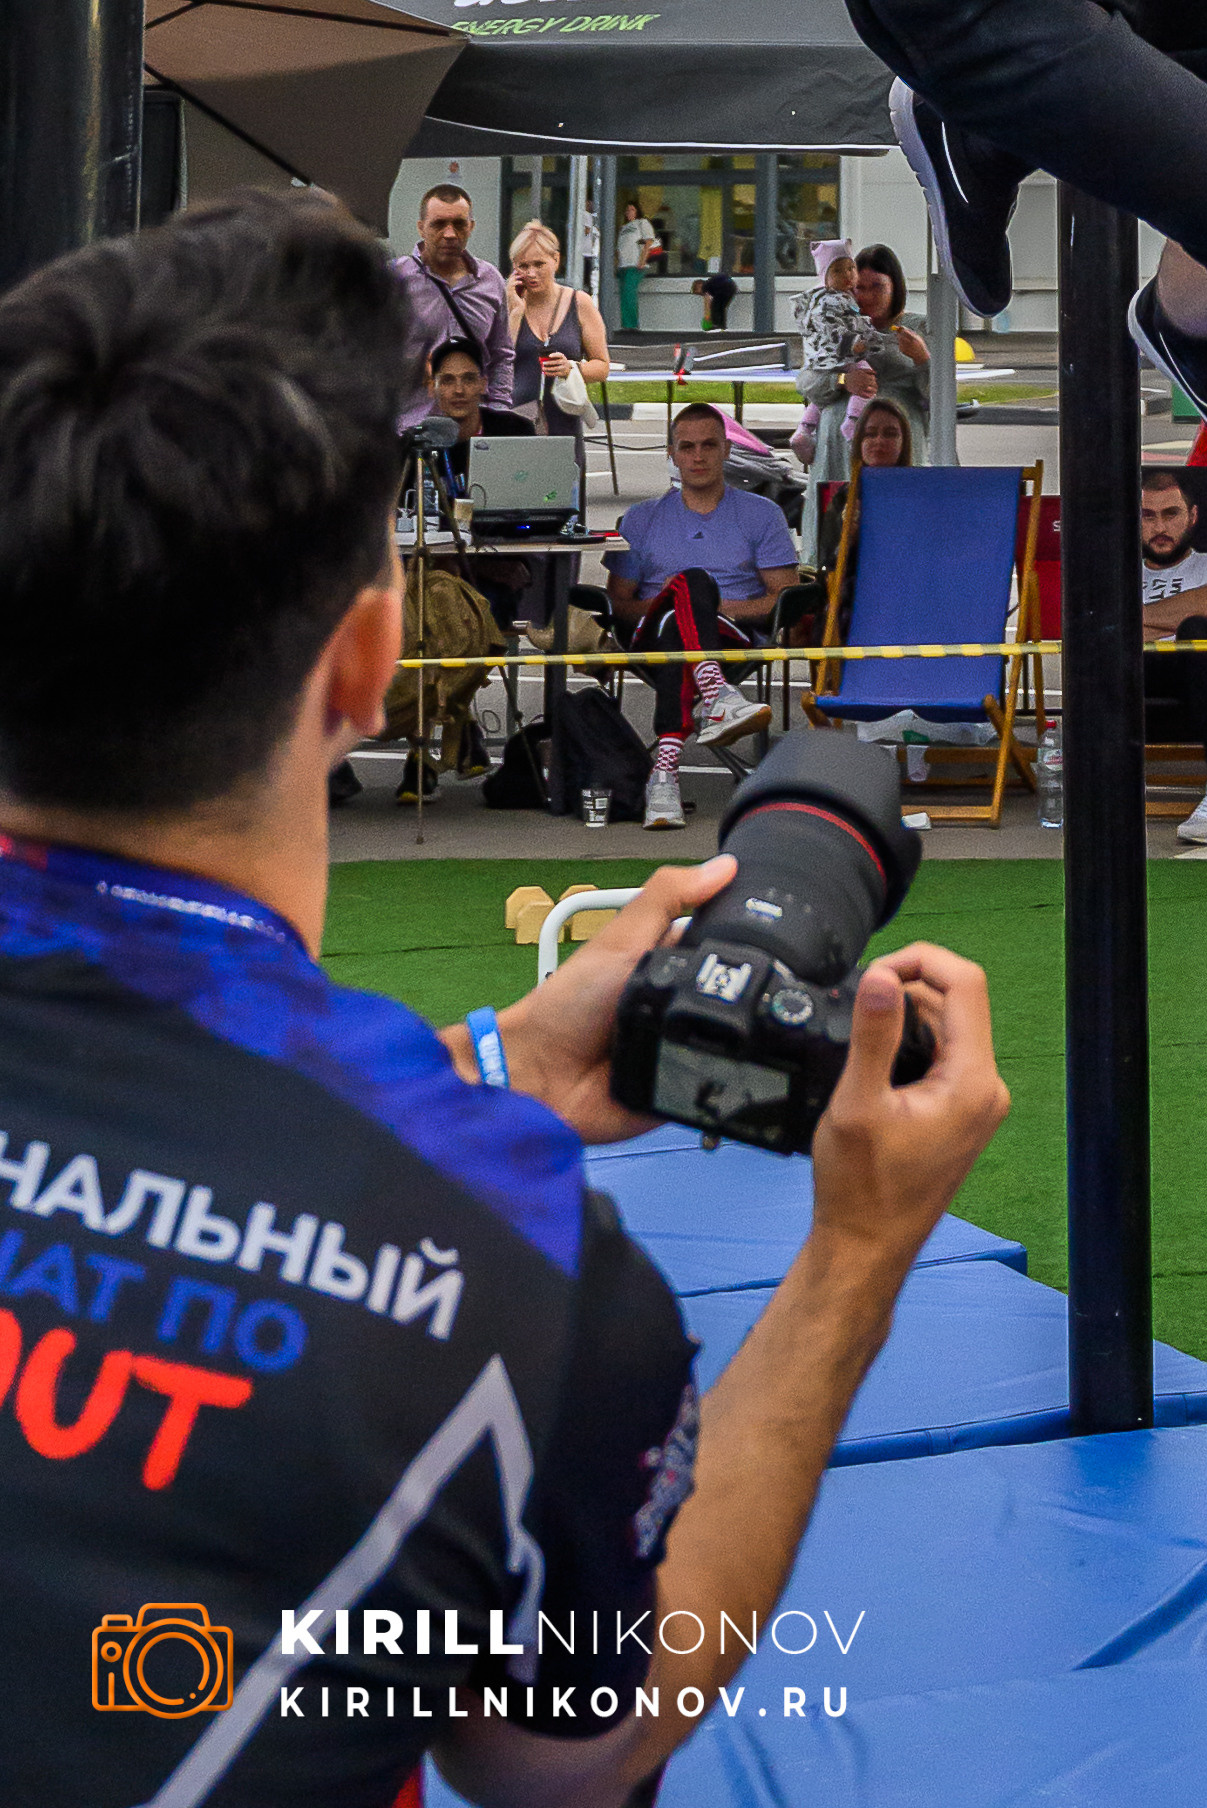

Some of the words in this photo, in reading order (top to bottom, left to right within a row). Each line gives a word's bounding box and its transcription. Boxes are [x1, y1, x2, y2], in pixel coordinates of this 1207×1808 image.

[451, 16, 559, 36] ENERGY
[560, 14, 661, 32] DRINK
[156, 1275, 308, 1374] ПО
[0, 1307, 253, 1491] UT
